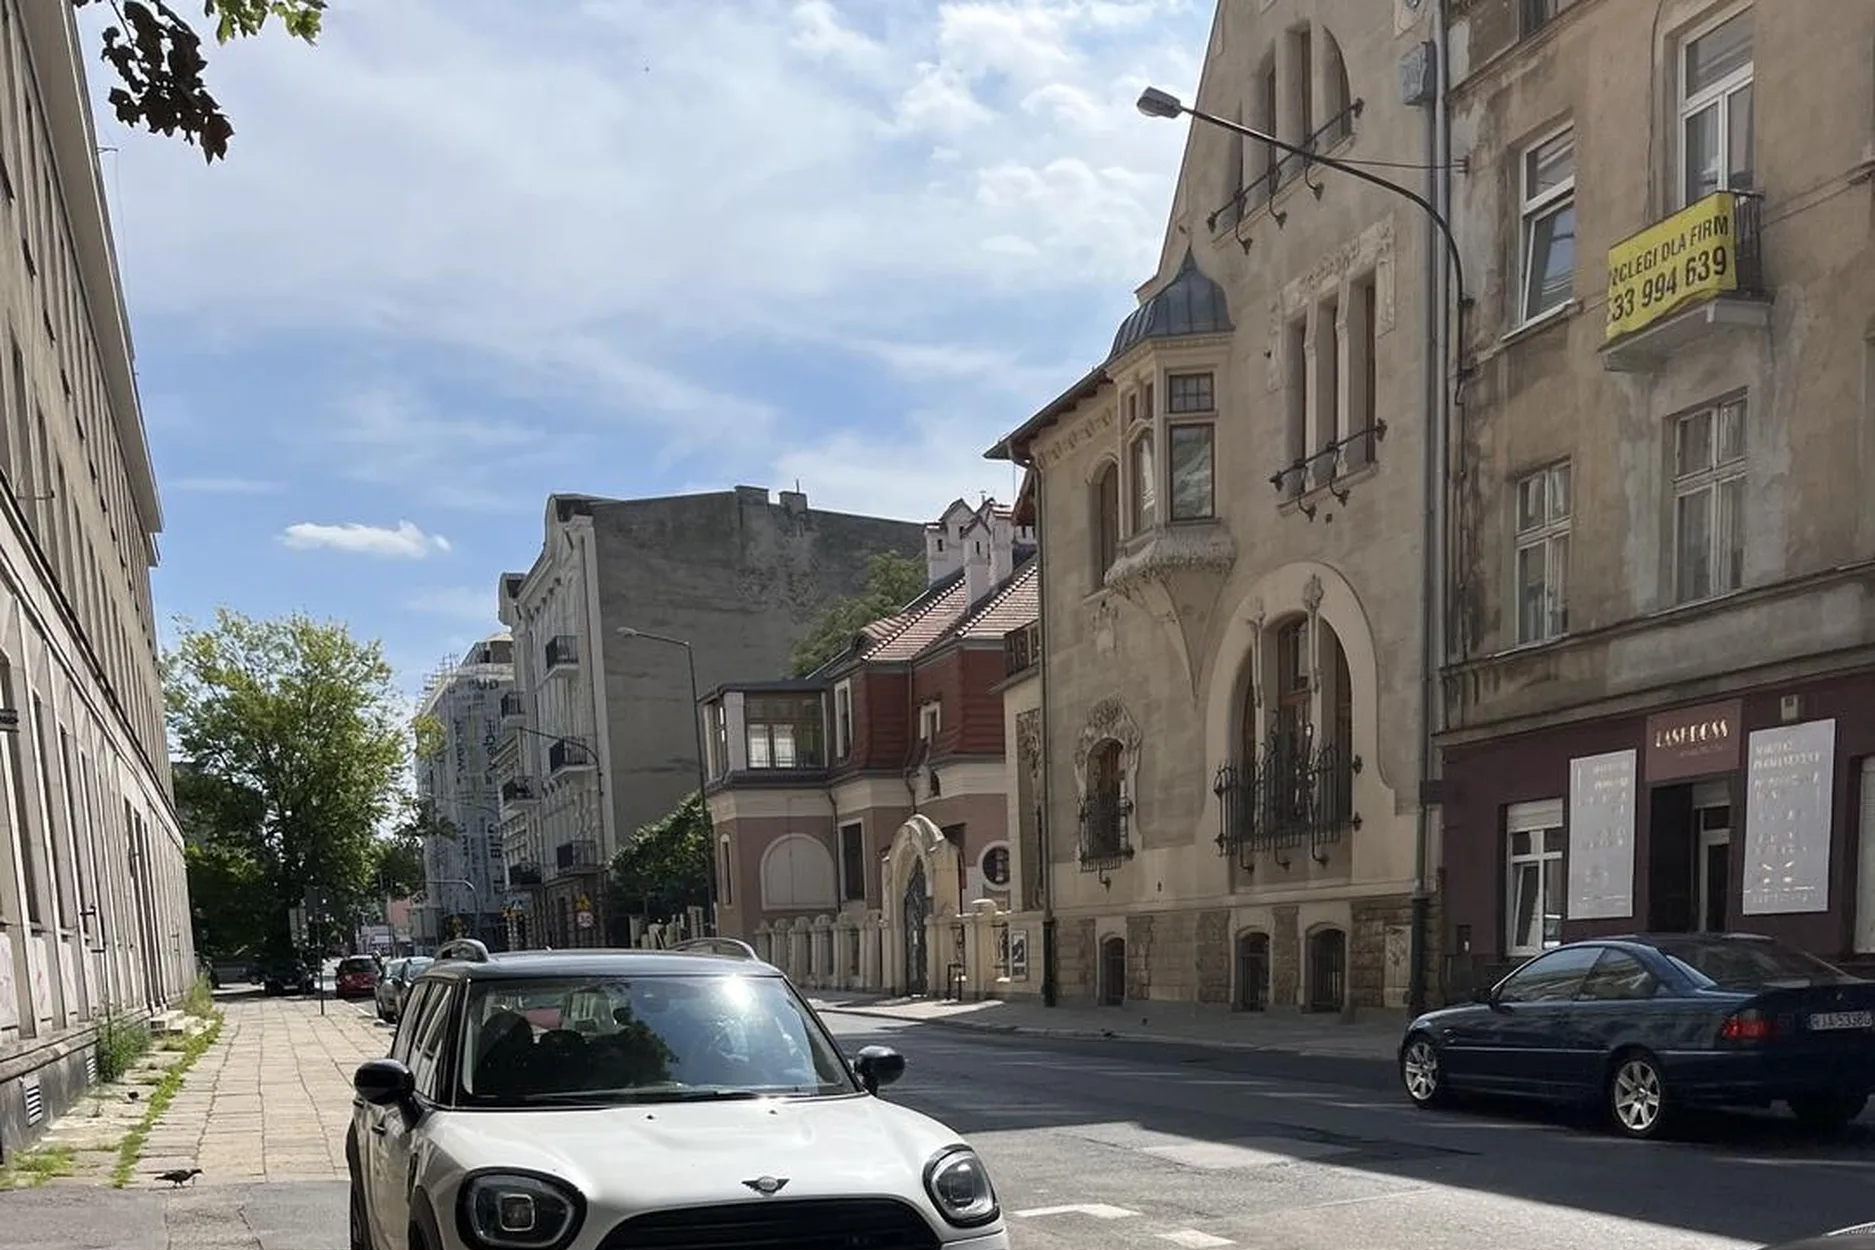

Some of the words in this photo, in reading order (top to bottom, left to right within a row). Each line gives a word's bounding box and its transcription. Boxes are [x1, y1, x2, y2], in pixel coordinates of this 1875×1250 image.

[1662, 235, 1687, 260] DLA
[1690, 215, 1729, 247] FIRM
[1641, 266, 1677, 308] 994
[1685, 247, 1727, 286] 639
